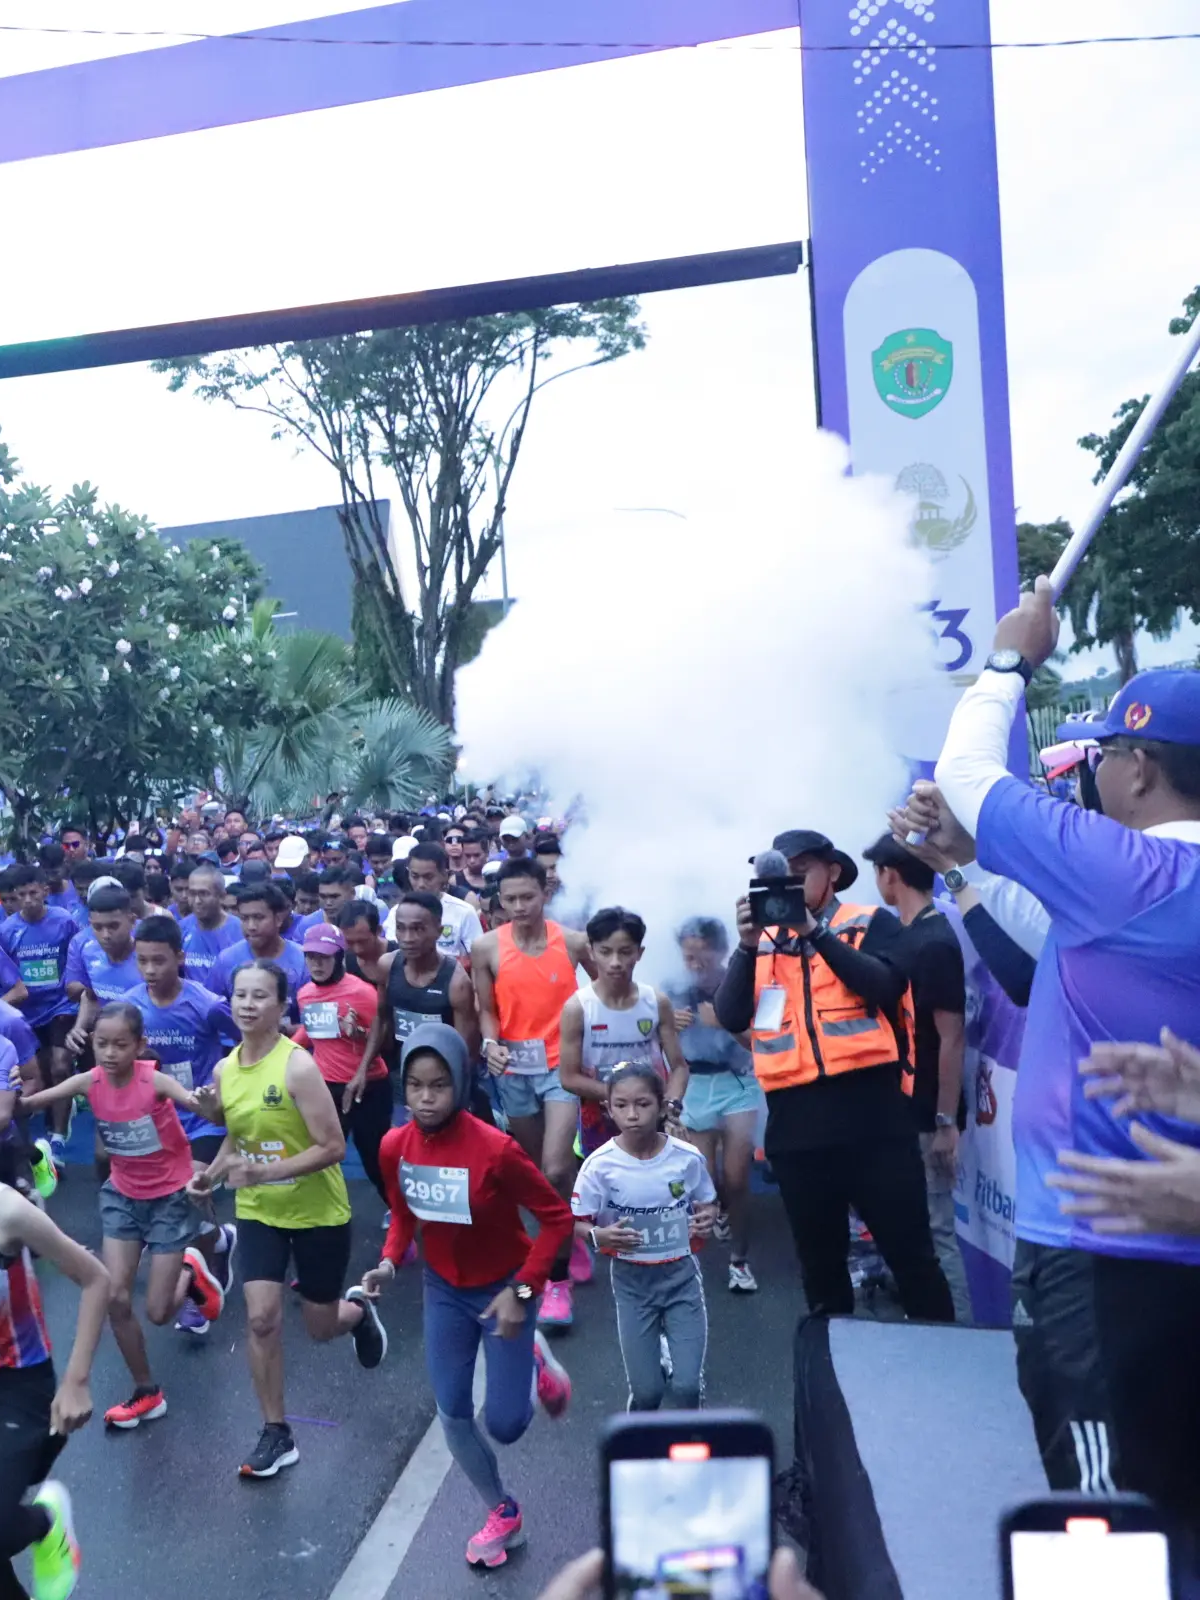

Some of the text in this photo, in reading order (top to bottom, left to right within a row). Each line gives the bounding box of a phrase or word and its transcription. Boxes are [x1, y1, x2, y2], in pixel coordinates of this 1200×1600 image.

[24, 966, 54, 978] 4358
[304, 1012, 334, 1026] 3340
[103, 1128, 151, 1144] 2542
[404, 1177, 461, 1204] 2967
